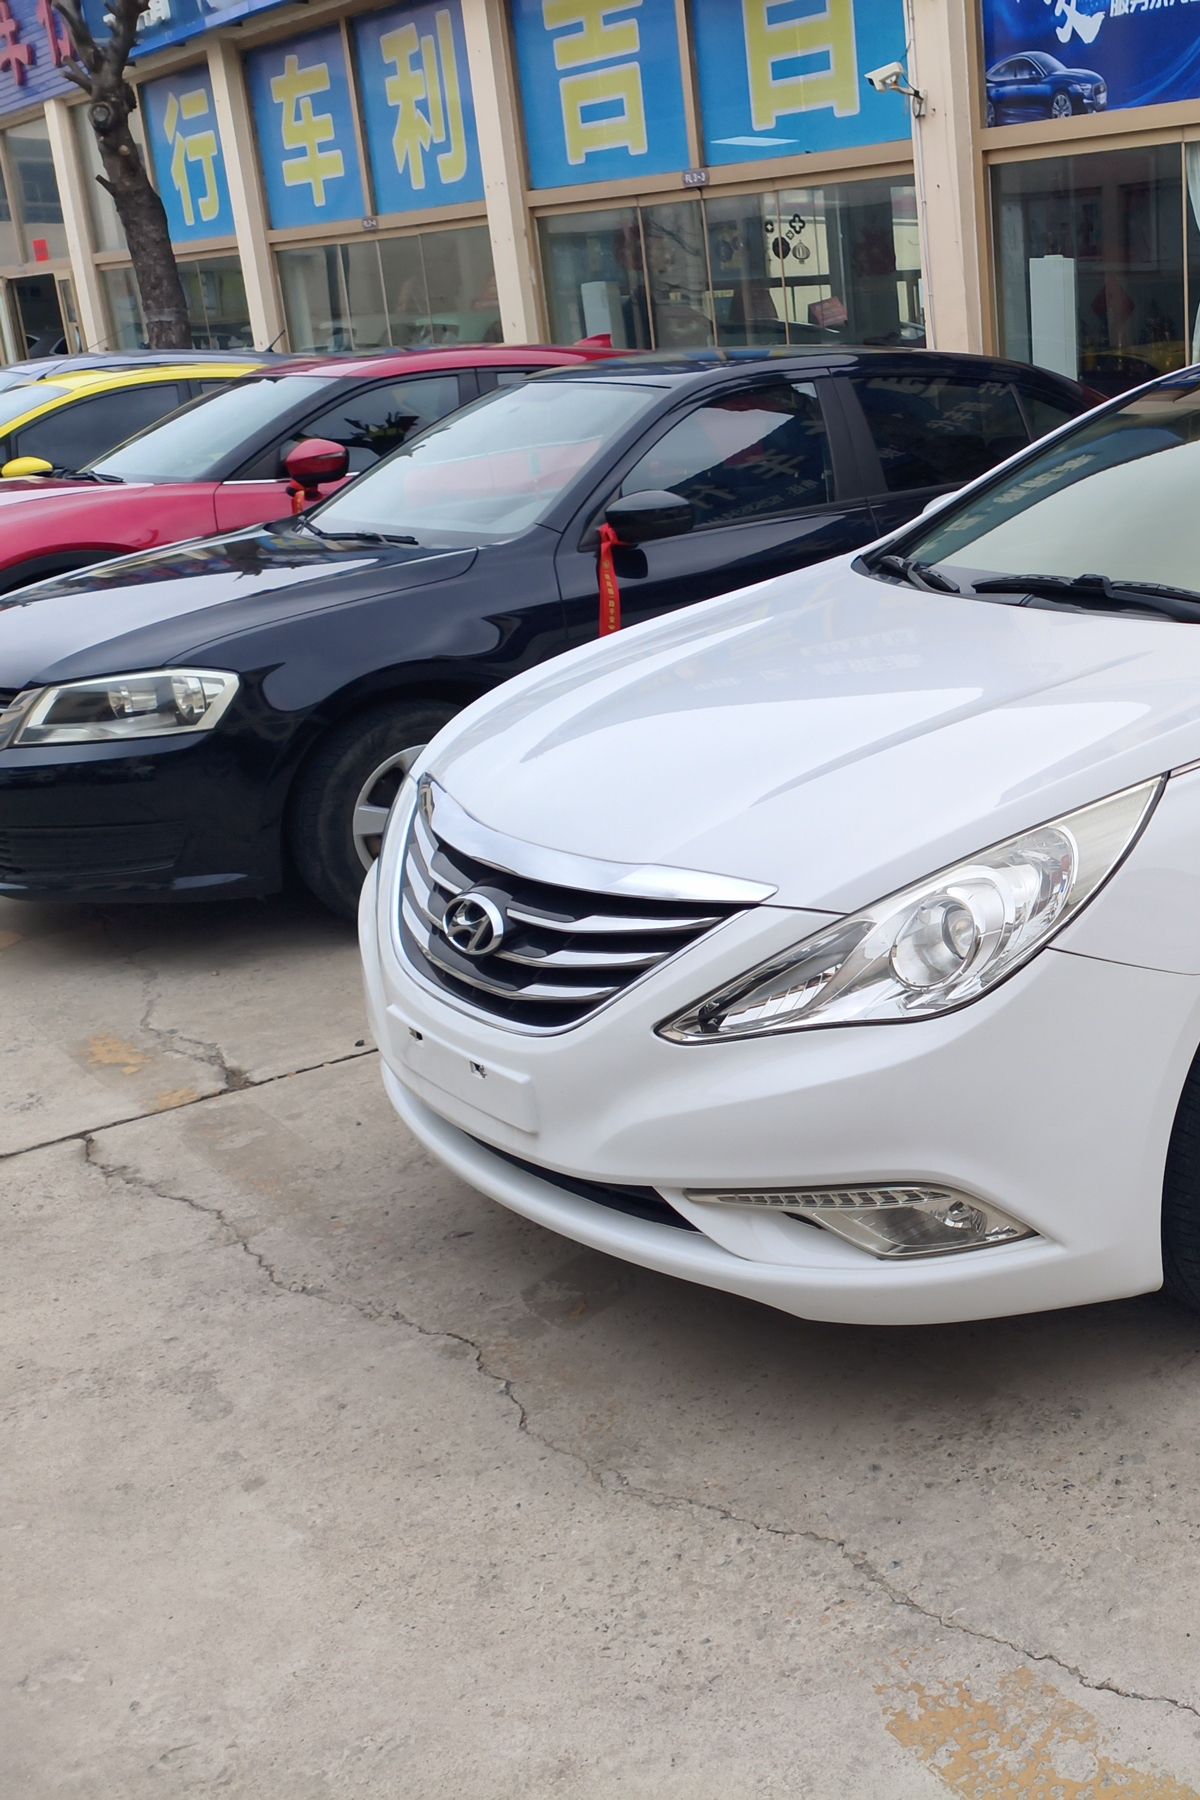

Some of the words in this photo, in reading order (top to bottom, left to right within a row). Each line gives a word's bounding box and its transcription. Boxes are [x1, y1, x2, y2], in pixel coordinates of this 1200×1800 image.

[164, 88, 219, 226] 行
[270, 54, 345, 207] 车
[380, 9, 468, 190] 利
